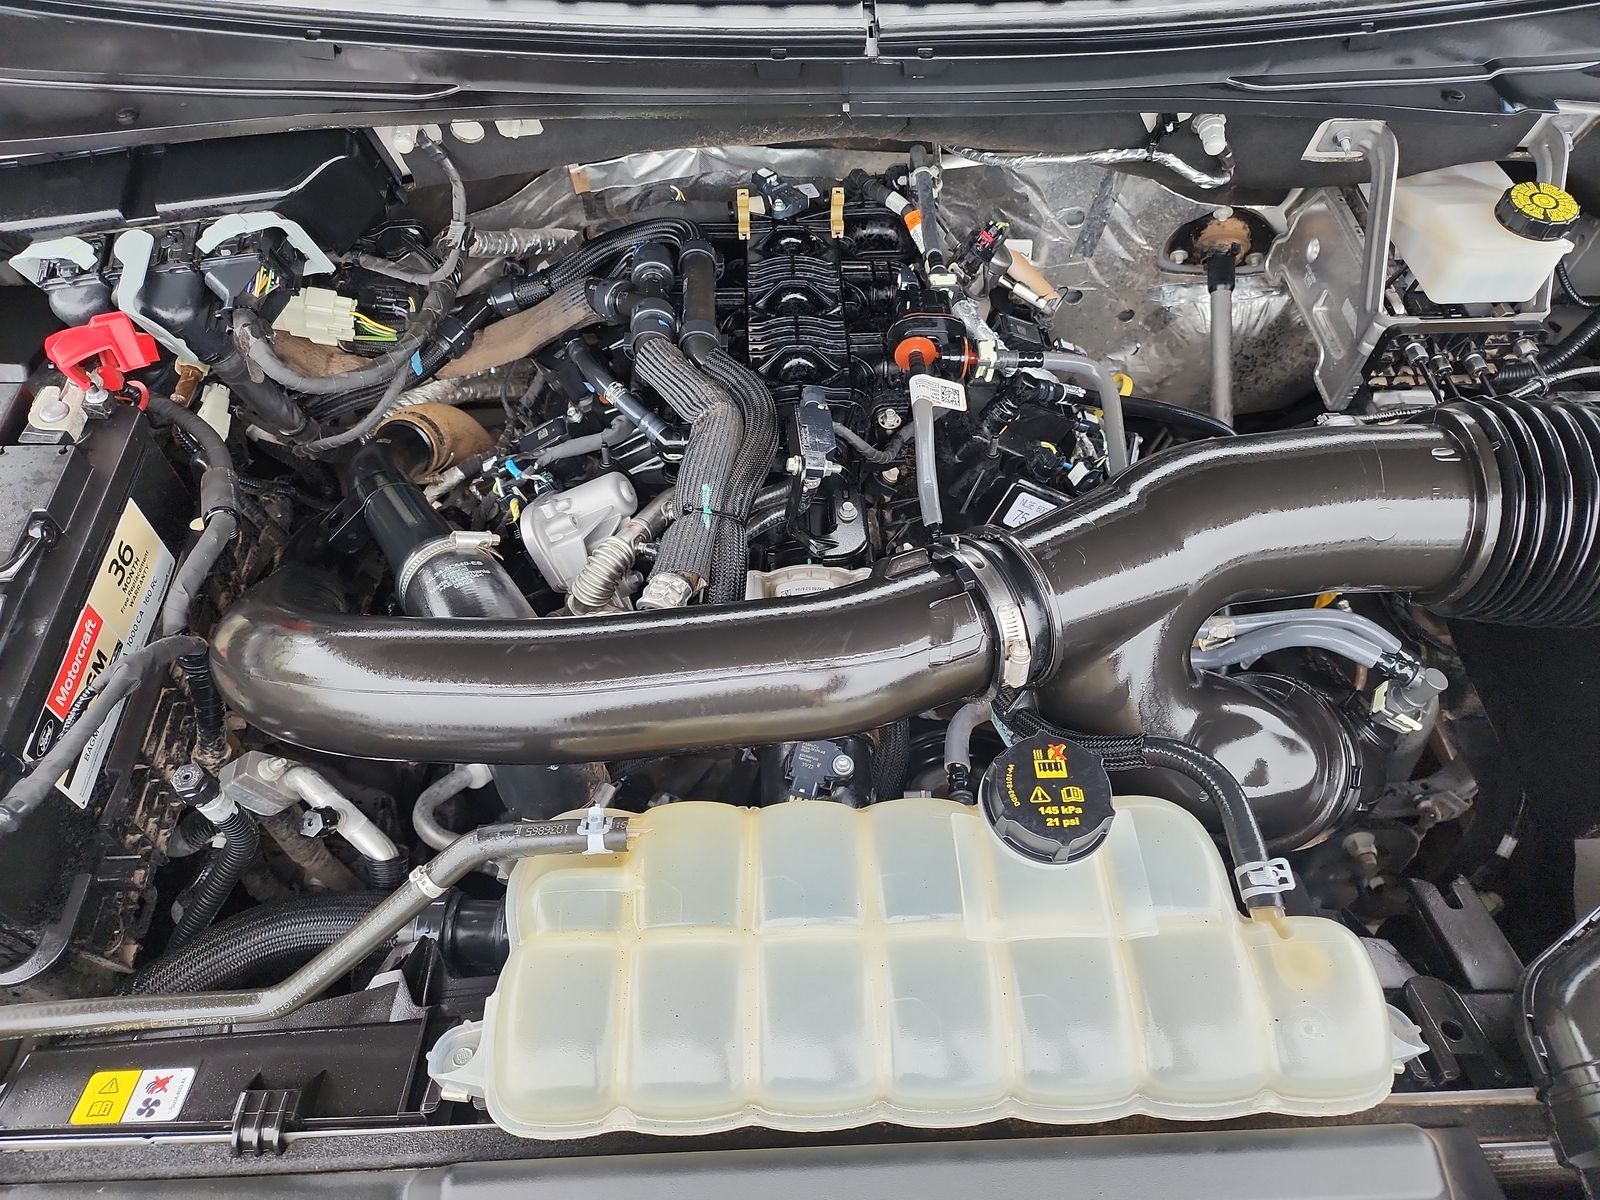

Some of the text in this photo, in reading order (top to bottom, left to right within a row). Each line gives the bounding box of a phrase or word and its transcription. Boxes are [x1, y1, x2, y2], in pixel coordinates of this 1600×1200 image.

[1012, 509, 1030, 525] 75
[107, 540, 134, 587] 36
[120, 550, 149, 614] Free Replacement
[121, 557, 140, 594] MONTH
[129, 565, 149, 607] WARRANTY
[126, 624, 139, 647] 1000
[136, 610, 145, 624] CA
[143, 589, 153, 605] 160
[150, 575, 158, 590] RC
[55, 618, 97, 707] Motorcraft
[1038, 805, 1083, 815] 145 kPa
[1045, 817, 1080, 828] 21 psi
